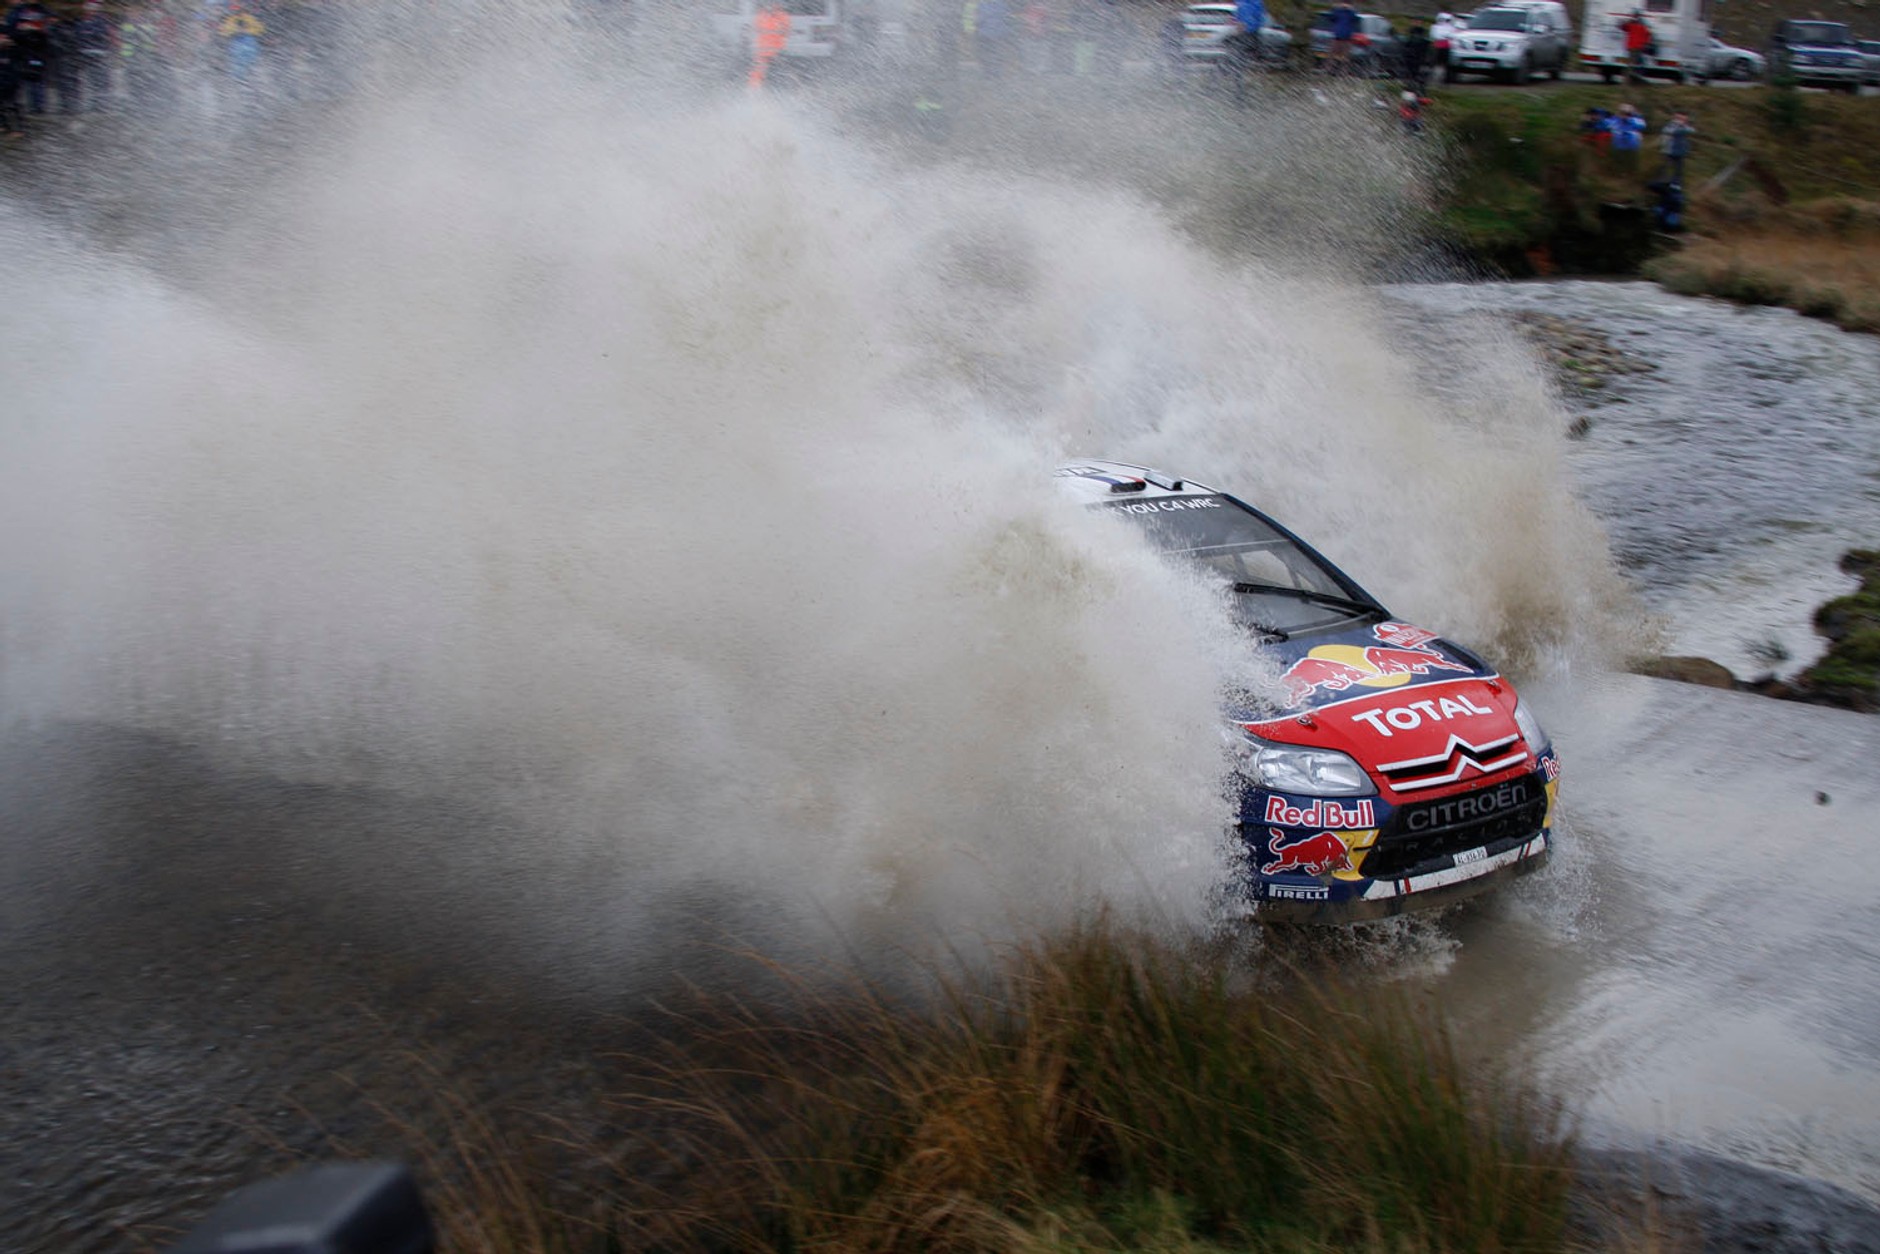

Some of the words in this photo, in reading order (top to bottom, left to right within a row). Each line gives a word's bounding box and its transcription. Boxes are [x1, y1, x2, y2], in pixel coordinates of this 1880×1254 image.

[1121, 503, 1160, 515] YOU
[1160, 500, 1186, 512] C4
[1182, 497, 1221, 510] WRC
[1352, 694, 1493, 737] TOTAL
[1265, 797, 1321, 828] Red
[1322, 800, 1376, 829] Bull
[1269, 884, 1329, 901] PIRELLI
